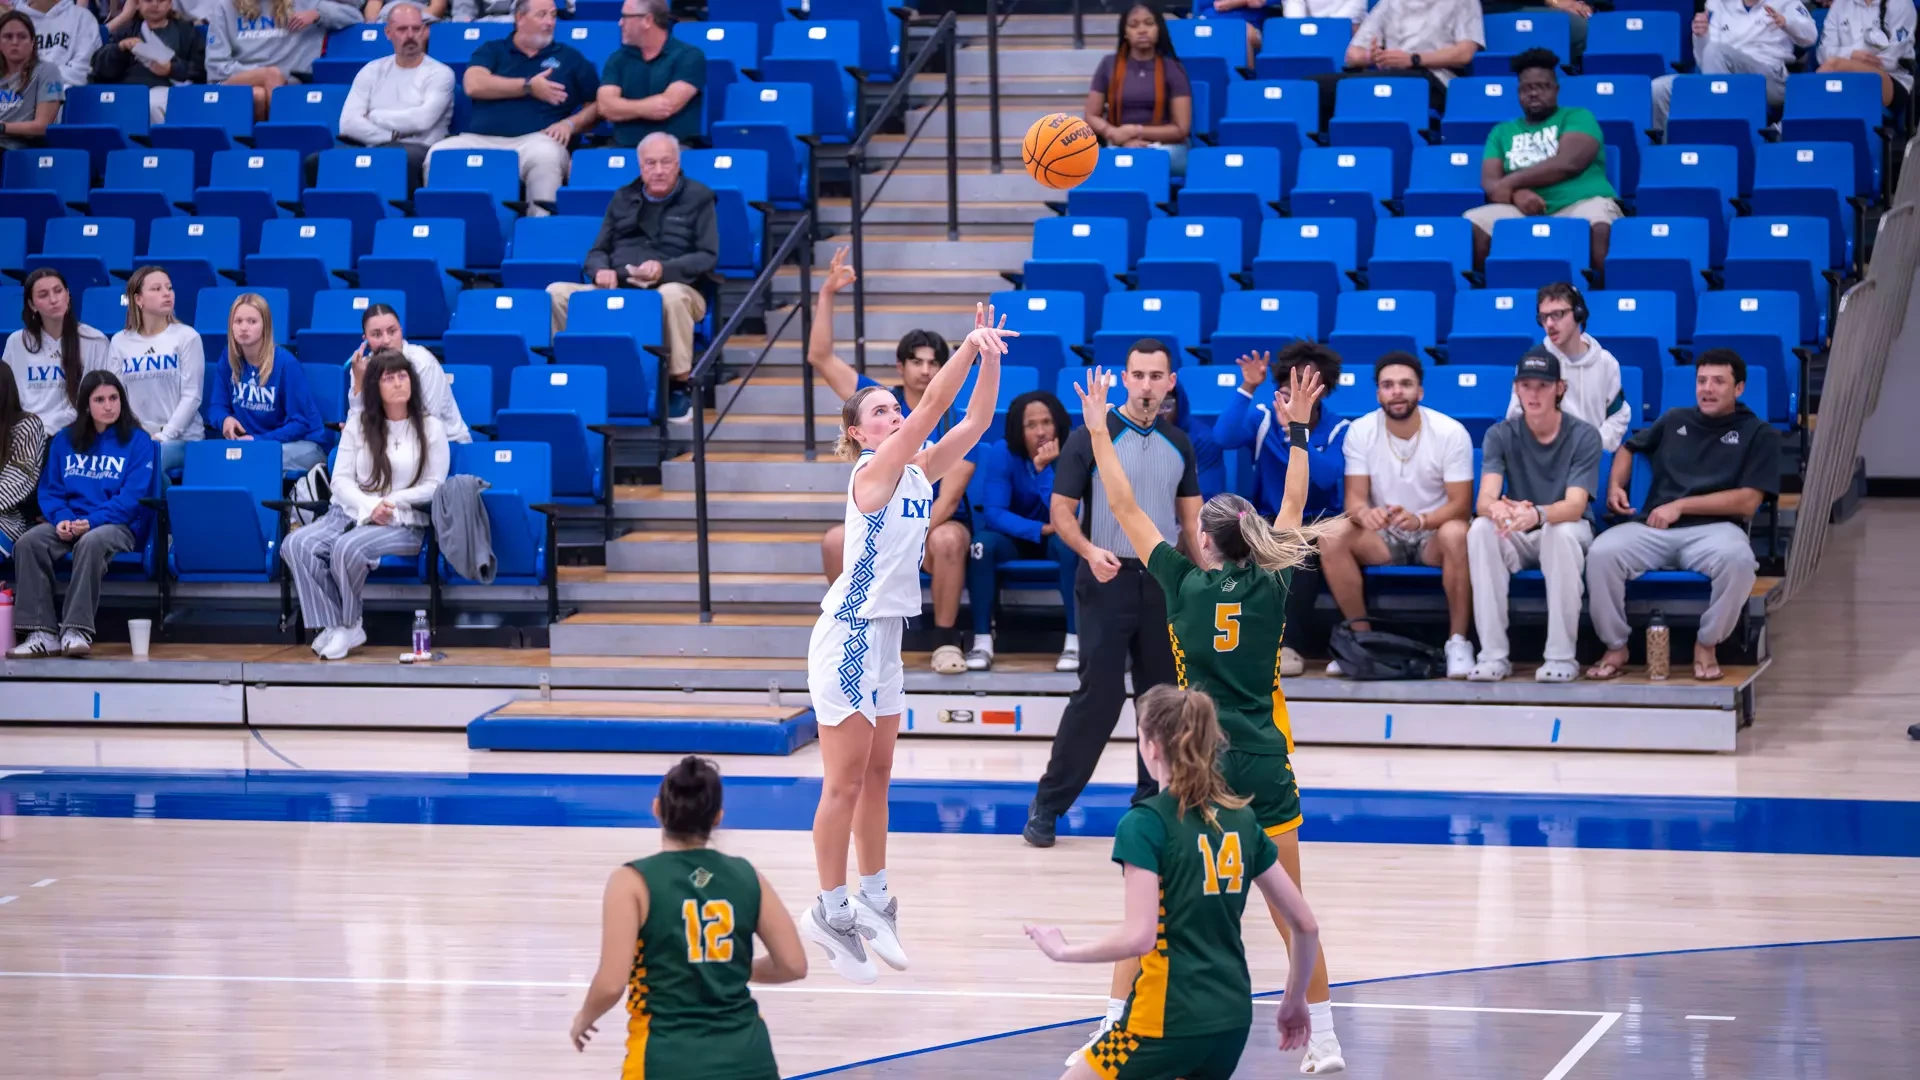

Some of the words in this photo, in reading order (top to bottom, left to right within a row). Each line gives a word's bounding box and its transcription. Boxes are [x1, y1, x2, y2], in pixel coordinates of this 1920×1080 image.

[236, 15, 276, 31] LYN
[27, 366, 67, 381] LYN
[123, 353, 178, 374] LYNN
[65, 453, 126, 473] LYNN
[970, 542, 984, 560] 13
[1213, 602, 1242, 652] 5
[1197, 831, 1244, 896] 14
[682, 899, 735, 963] 12
